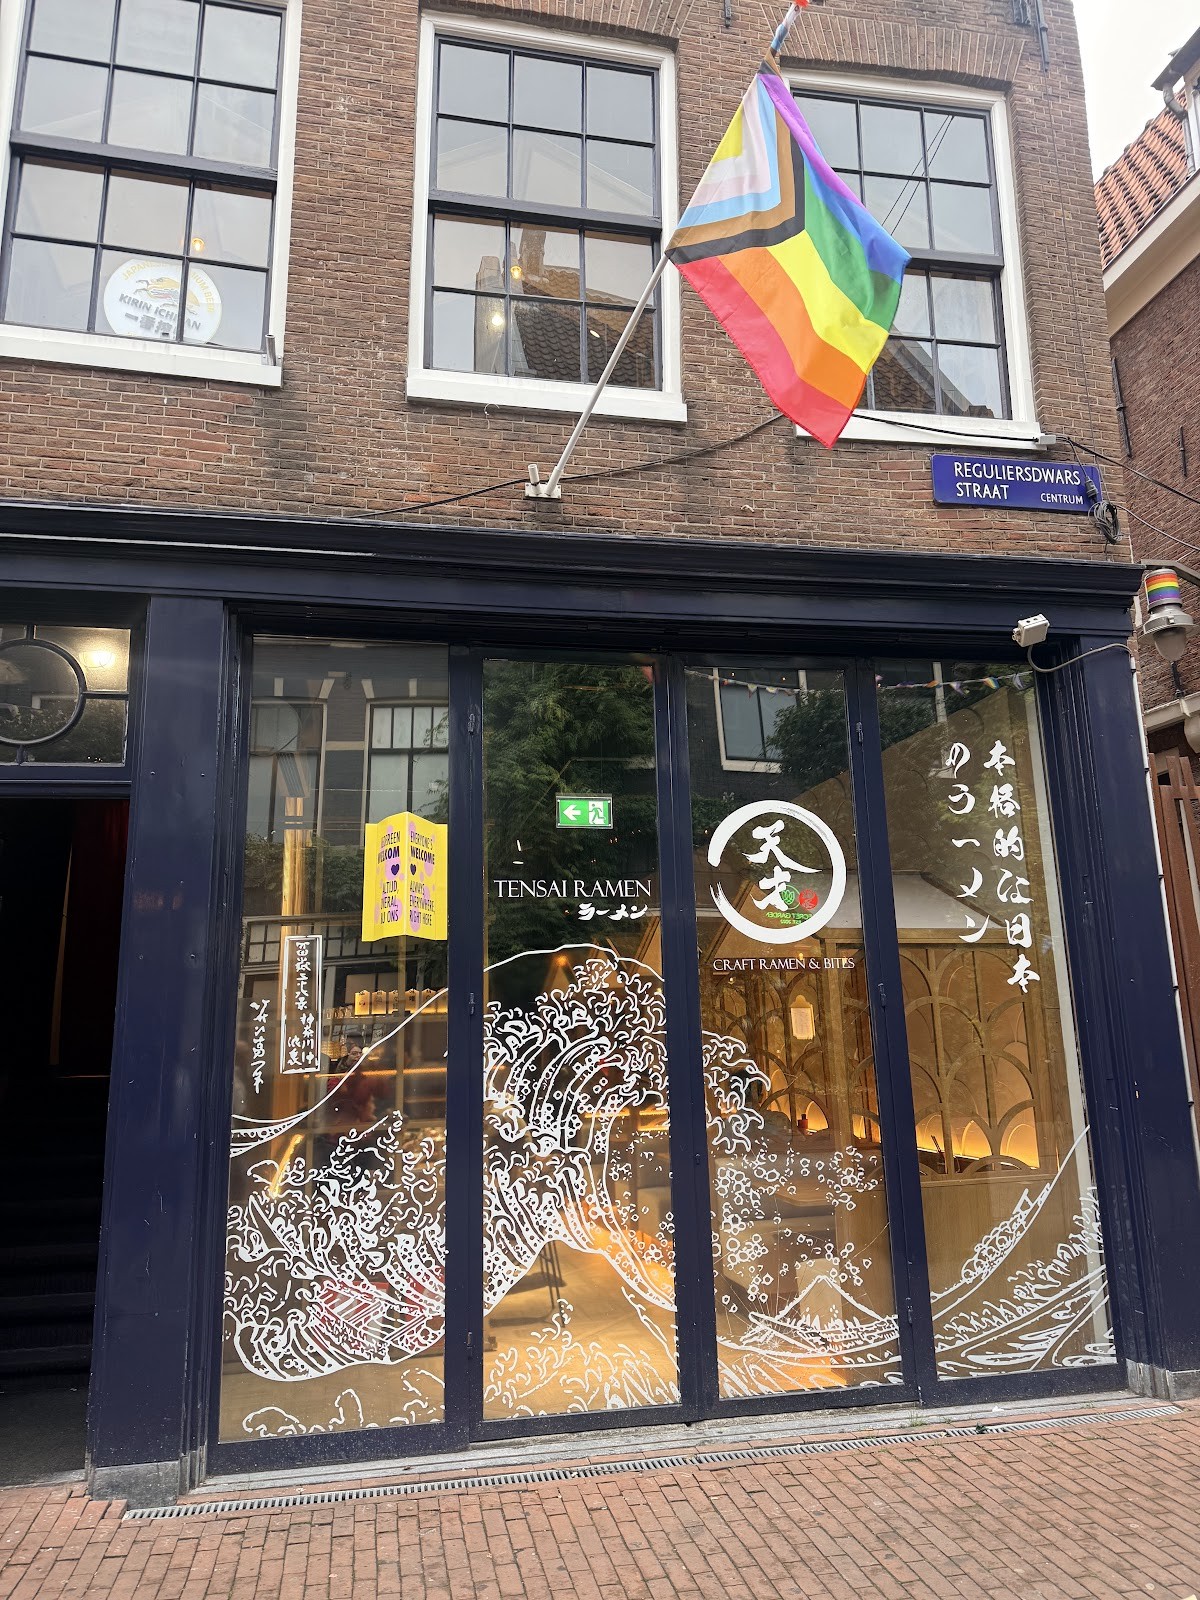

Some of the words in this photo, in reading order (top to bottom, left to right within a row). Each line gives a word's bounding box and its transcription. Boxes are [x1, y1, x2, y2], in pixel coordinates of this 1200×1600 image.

[118, 293, 152, 312] KIRIN
[154, 306, 201, 330] ICHIAN
[125, 313, 177, 339] 一番搾
[954, 461, 1081, 486] REGULIERSDWARS
[956, 482, 1010, 500] STRAAT
[1040, 492, 1083, 505] CENTRUM
[410, 845, 435, 865] WELCOME
[493, 879, 567, 898] TENSAI
[573, 879, 651, 898] RAMEN
[577, 902, 649, 921] ラーメン
[713, 958, 756, 971] CRAFT
[759, 958, 805, 970] RAMEN
[809, 958, 820, 970] &
[824, 957, 855, 969] BITES
